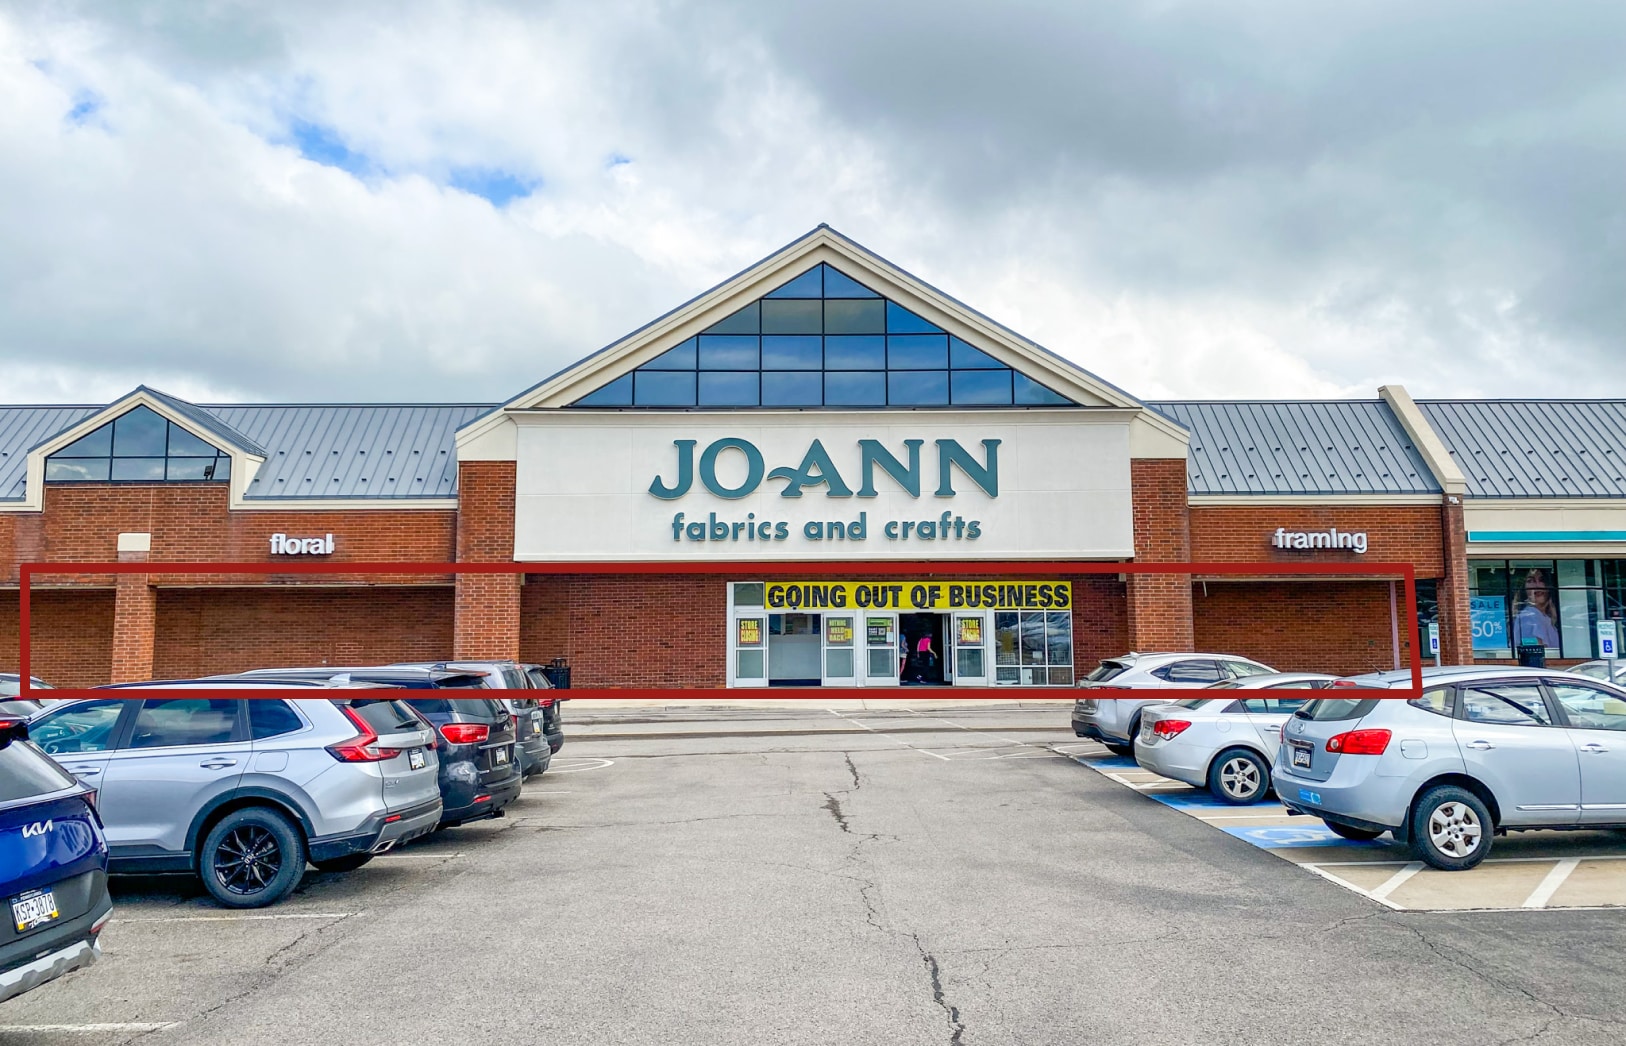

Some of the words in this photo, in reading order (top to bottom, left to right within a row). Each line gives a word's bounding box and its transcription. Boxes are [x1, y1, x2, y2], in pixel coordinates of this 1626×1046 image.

[672, 512, 789, 542] fabrics
[803, 511, 867, 541] and
[884, 510, 982, 541] crafts
[269, 533, 333, 555] floral
[1274, 527, 1368, 554] framing
[767, 584, 846, 608] GOING
[855, 584, 902, 608] OUT
[910, 584, 941, 608] OF
[951, 584, 1069, 608] BUSINESS
[1470, 601, 1500, 609] SALE
[741, 620, 758, 629] STORE
